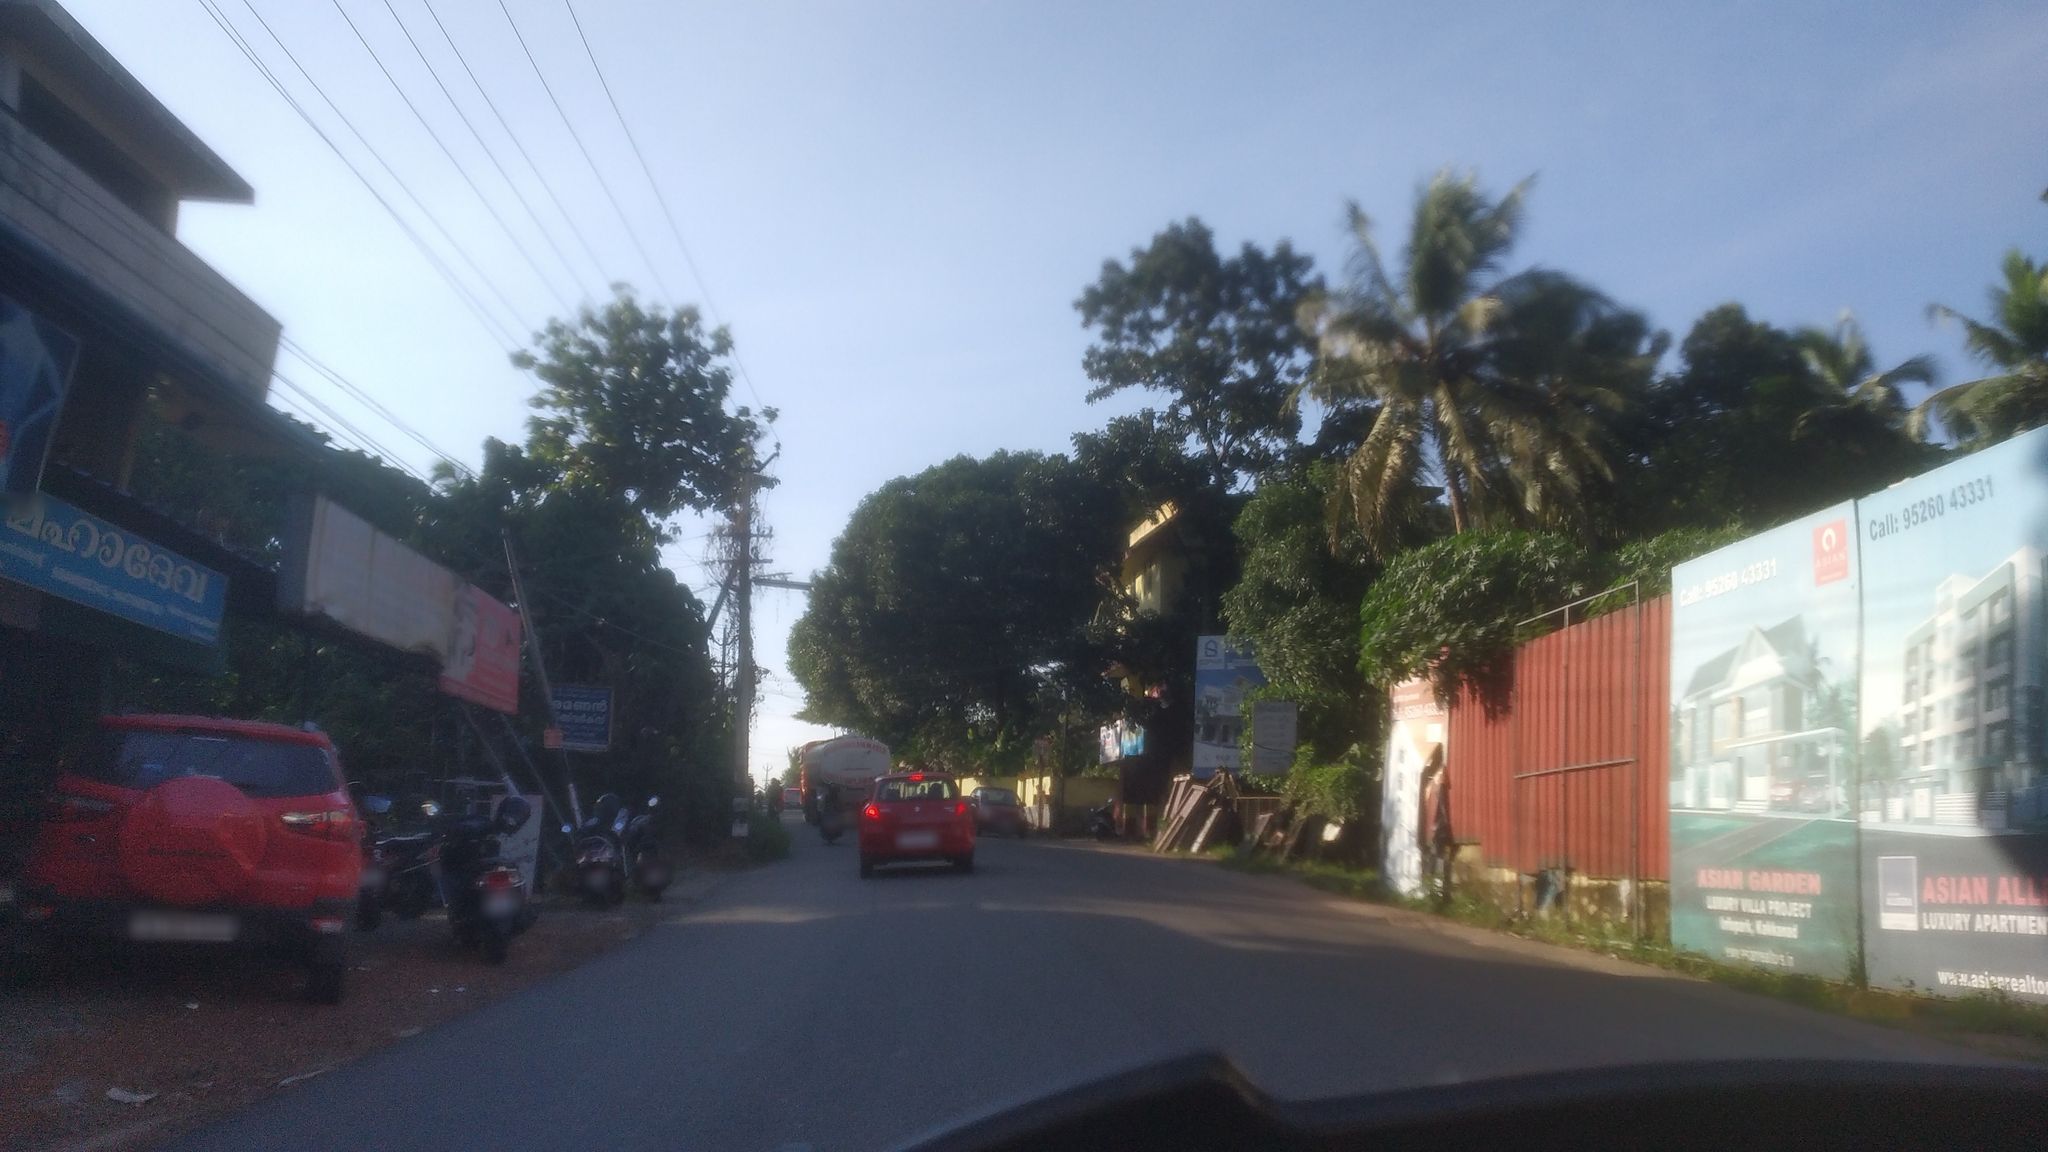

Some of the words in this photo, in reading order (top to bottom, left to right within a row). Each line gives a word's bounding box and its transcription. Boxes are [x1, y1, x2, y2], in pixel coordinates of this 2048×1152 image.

[1869, 513, 1899, 541] Call:
[1903, 494, 1945, 530] 95260
[1950, 474, 1994, 510] 43331
[1741, 557, 1776, 585] 43331
[1698, 868, 1744, 890] ASIAN
[1749, 870, 1821, 895] GARDEN
[1922, 876, 1990, 904] ASIAN
[1768, 900, 1812, 918] PROJECT
[1922, 912, 1971, 931] LUXURY
